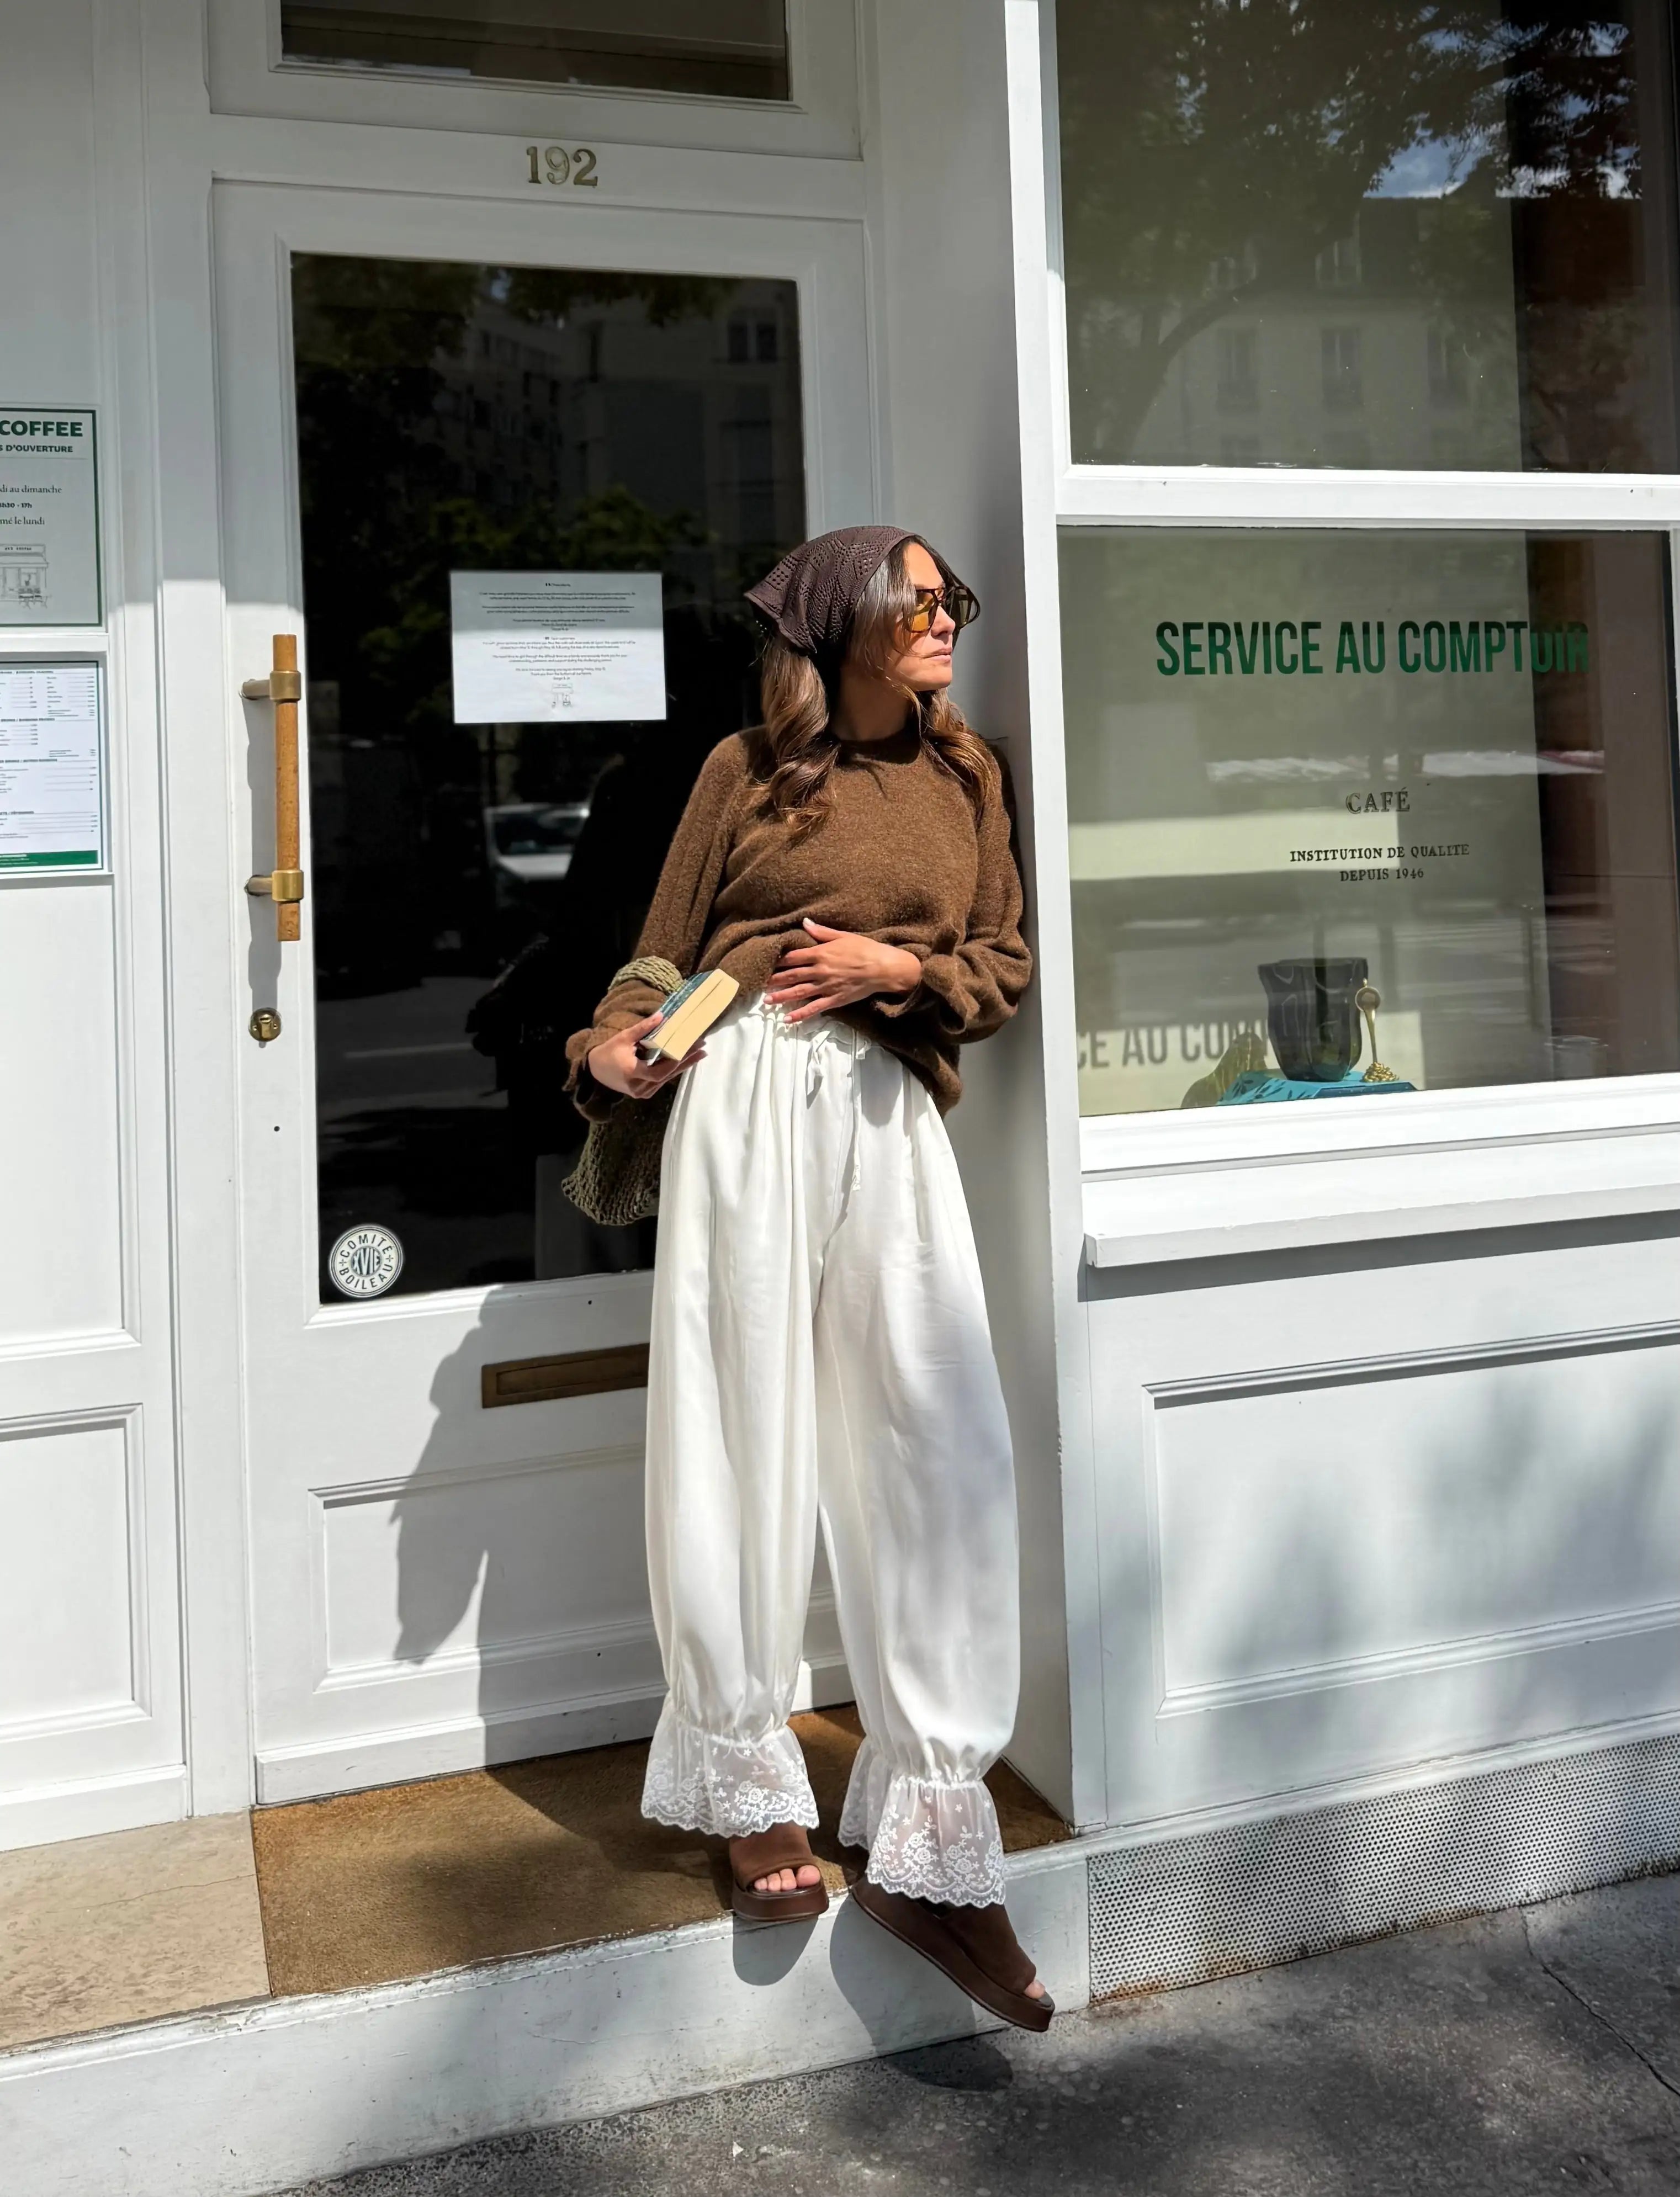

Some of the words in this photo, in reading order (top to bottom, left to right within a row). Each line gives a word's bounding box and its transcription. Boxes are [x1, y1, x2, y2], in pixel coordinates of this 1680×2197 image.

[526, 146, 598, 186] 192
[0, 420, 83, 437] COFFEE
[6, 444, 73, 453] D'OUVERTURE
[22, 485, 62, 493] dimanche
[14, 516, 22, 524] le
[24, 516, 45, 525] lundi
[1156, 621, 1323, 676] SERVICE
[1336, 621, 1385, 673] AU
[1398, 620, 1589, 673] COMPTOIR
[1345, 787, 1410, 814] CAFÉ
[1290, 847, 1382, 862] INSTITUTION
[1387, 846, 1405, 858] DE
[1411, 844, 1470, 858] QUALITE
[1340, 868, 1389, 882] DEPUIS
[1396, 868, 1424, 879] 1946
[339, 1264, 393, 1290] BOILEAU
